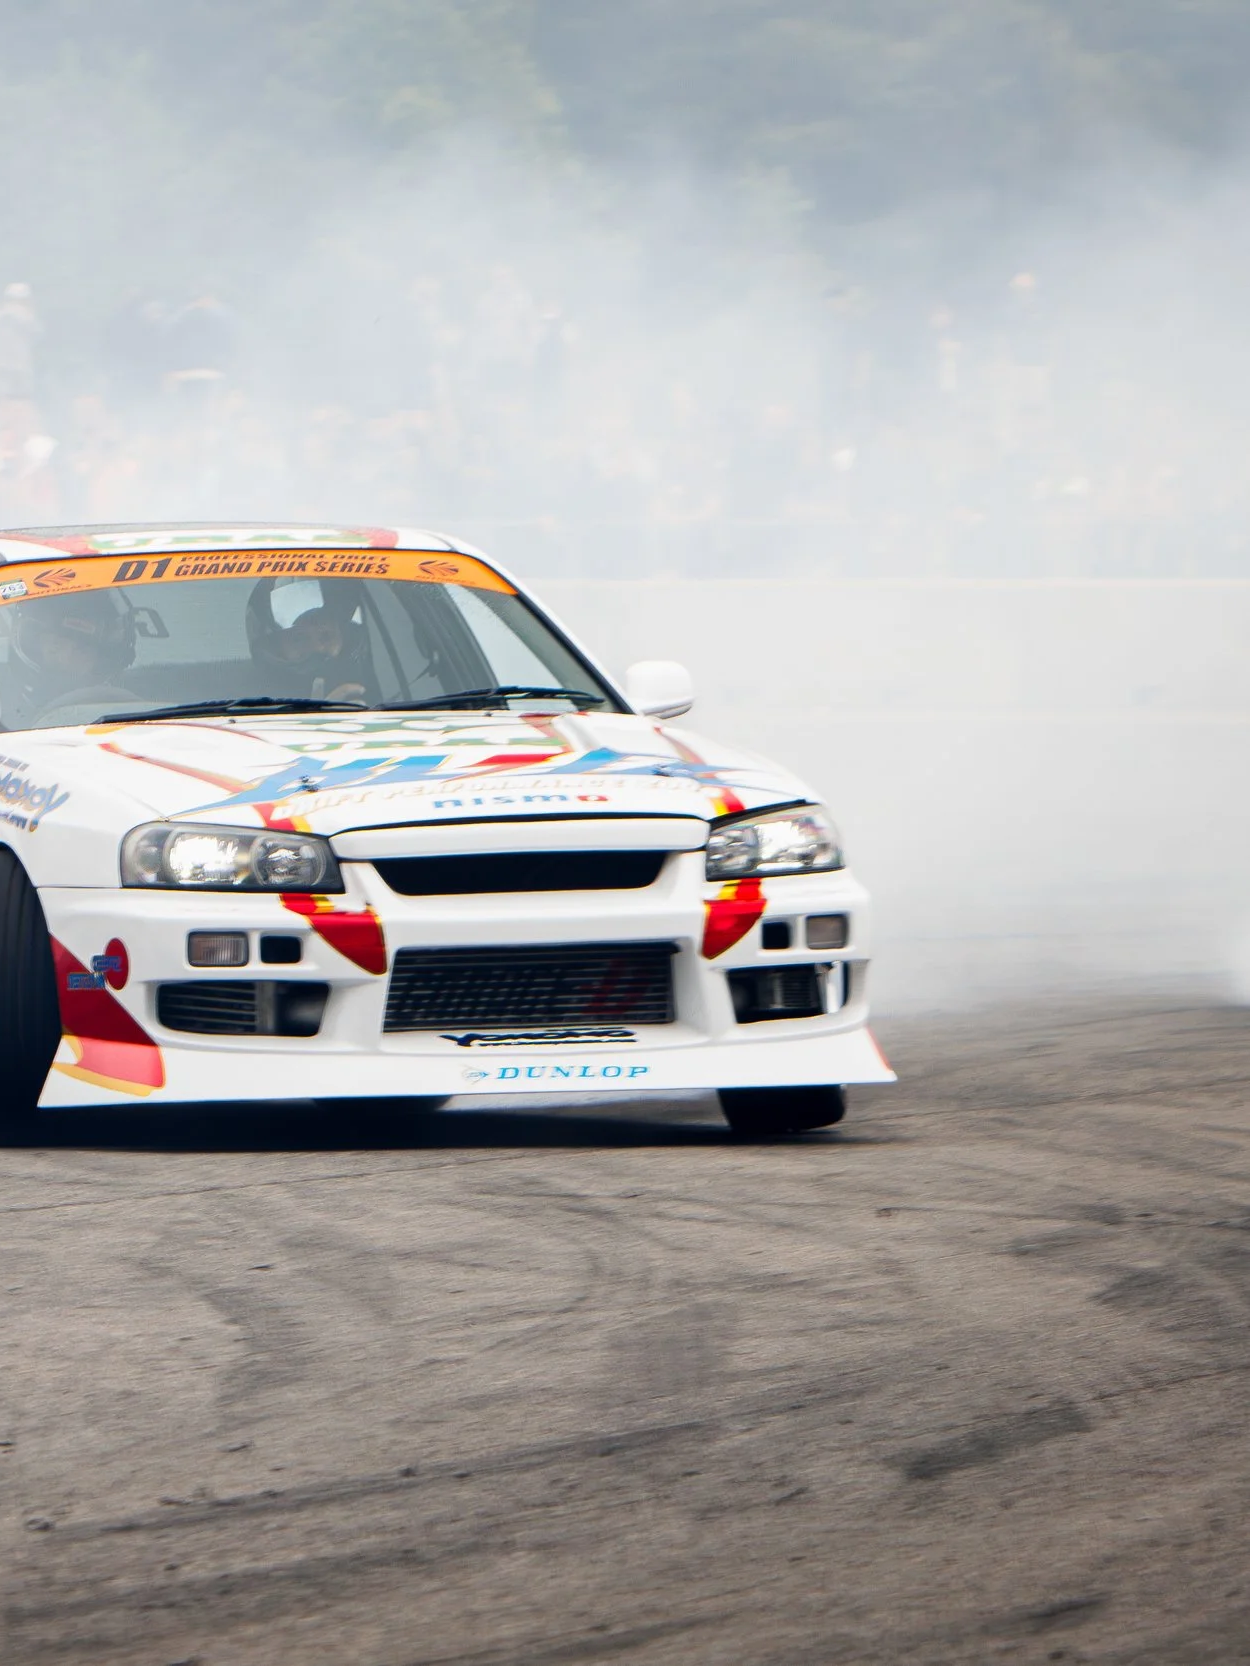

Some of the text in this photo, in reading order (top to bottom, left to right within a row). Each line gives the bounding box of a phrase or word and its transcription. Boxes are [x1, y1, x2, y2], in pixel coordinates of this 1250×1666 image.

[111, 557, 173, 583] D1
[174, 560, 391, 577] GRAND PRIX SERIES
[432, 794, 610, 809] nismo
[496, 1065, 649, 1080] DUNLOP
